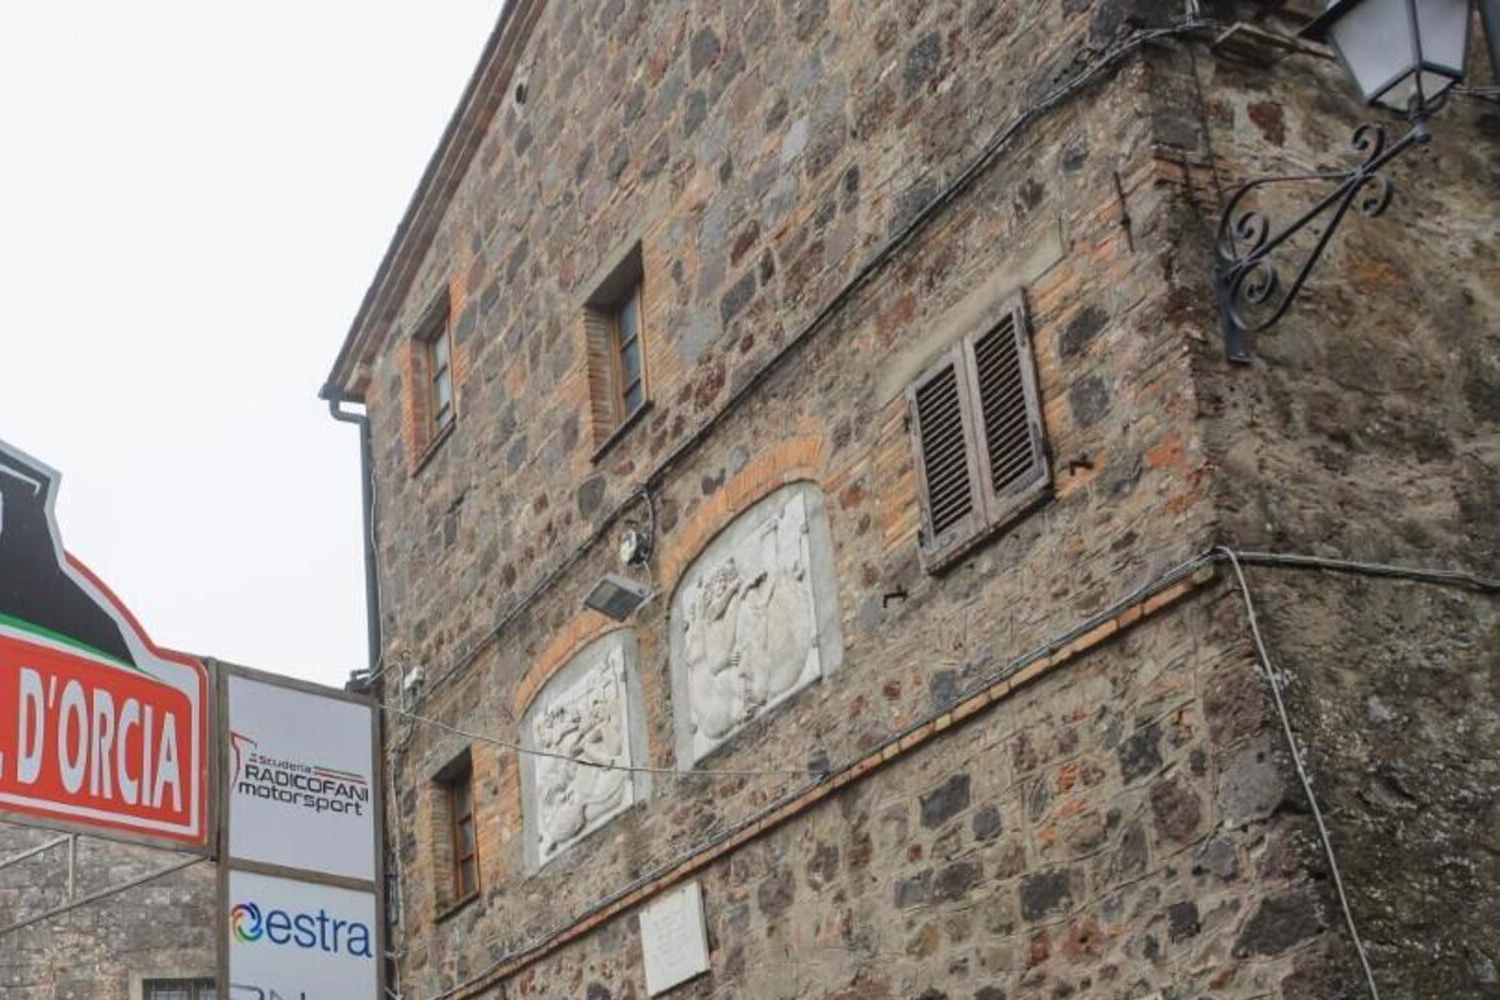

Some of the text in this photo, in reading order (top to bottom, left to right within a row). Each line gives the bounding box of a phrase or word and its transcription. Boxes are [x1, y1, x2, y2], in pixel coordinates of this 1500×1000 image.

[16, 667, 183, 813] D'ORCIA
[245, 764, 369, 802] RADICOFANI
[258, 754, 313, 775] Scuderia
[238, 782, 363, 816] motorsport
[265, 908, 373, 958] estra
